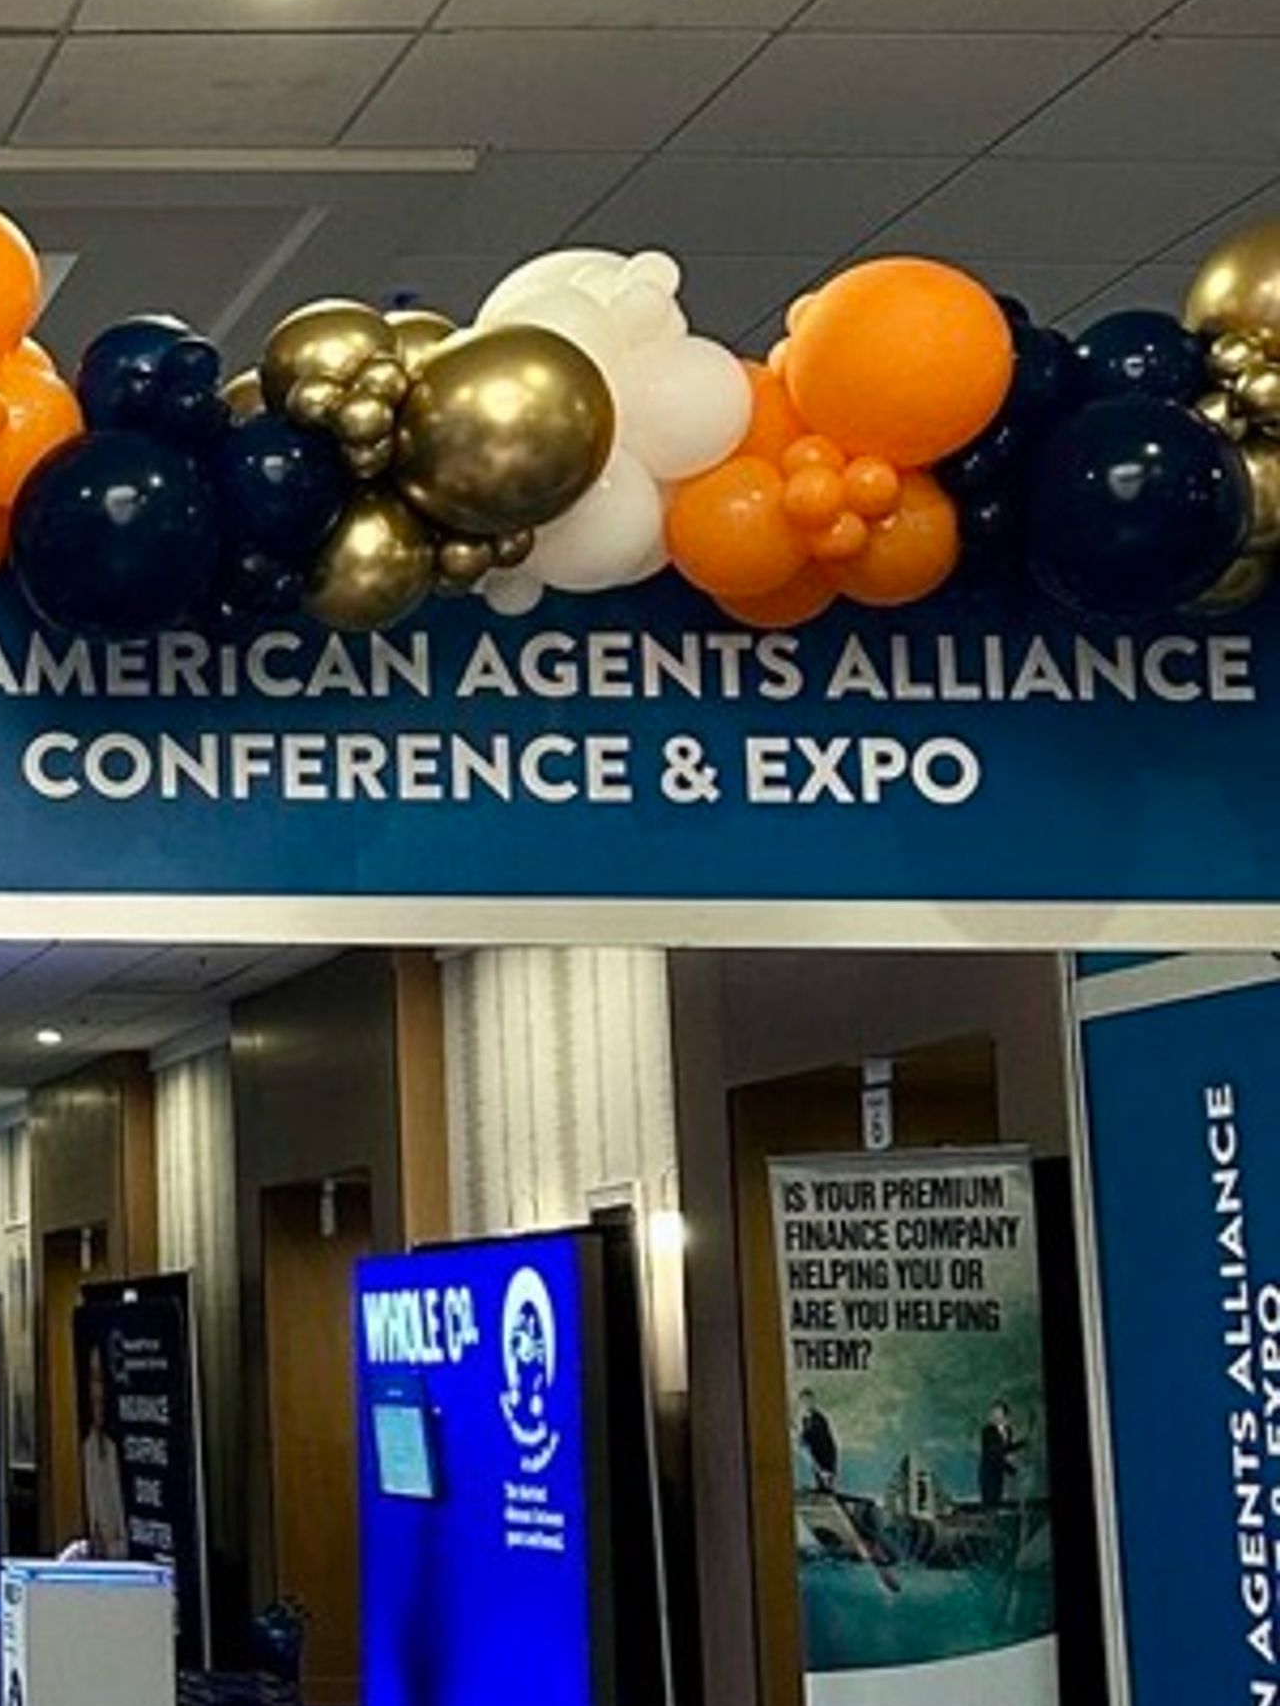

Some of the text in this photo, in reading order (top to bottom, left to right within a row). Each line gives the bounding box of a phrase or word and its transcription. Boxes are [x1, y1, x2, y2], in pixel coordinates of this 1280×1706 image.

[456, 632, 804, 700] AGENTS
[826, 635, 1256, 702] ALLIANCE
[21, 731, 980, 805] CONFERENCE & EXPO
[784, 1176, 1004, 1212] IS YOUR PREMIUM
[785, 1216, 1020, 1251] FINANCE COMPANY
[1205, 1083, 1256, 1393] ALLIANCE
[788, 1258, 984, 1290] HELPING YOU OR
[362, 1288, 444, 1365] WHOLE
[791, 1299, 1001, 1332] ARE YOU HELPING
[792, 1339, 873, 1371] THEM?
[1230, 1408, 1276, 1664] AGENTS
